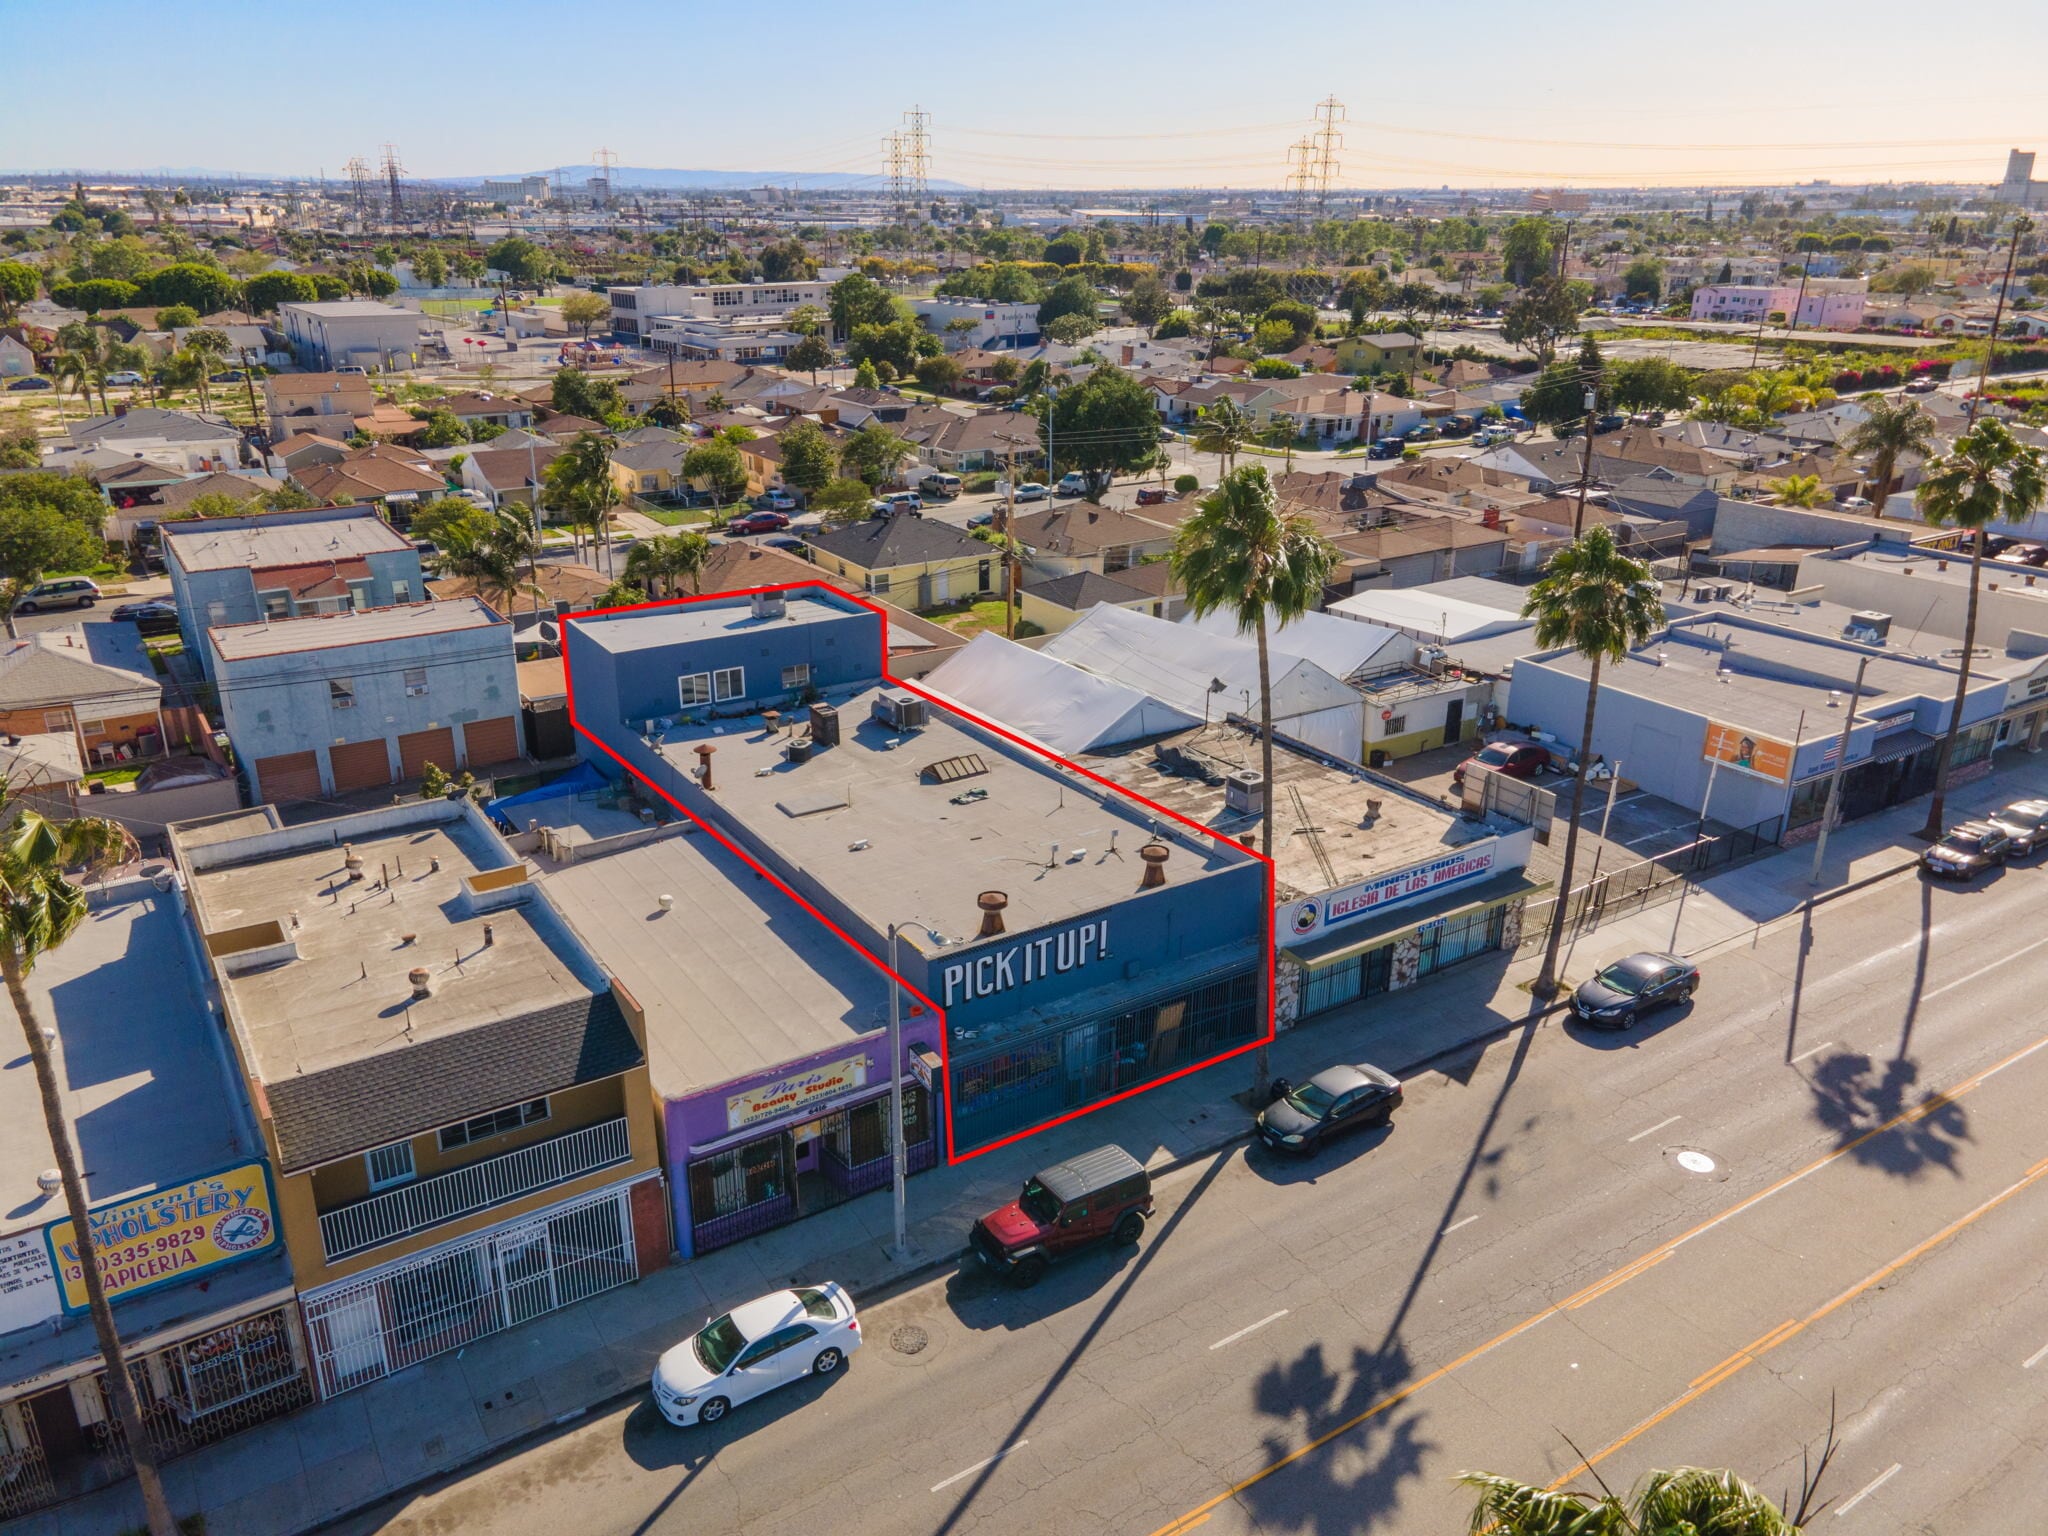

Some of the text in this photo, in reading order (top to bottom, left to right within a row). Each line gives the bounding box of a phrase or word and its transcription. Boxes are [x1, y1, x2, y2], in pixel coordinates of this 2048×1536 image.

[1332, 887, 1379, 917] IGLESIA
[1384, 883, 1399, 900] DE
[1405, 874, 1428, 893] LAS
[1433, 853, 1492, 884] AMERICAS
[1364, 854, 1466, 893] MINISTERIOS
[944, 919, 1108, 1008] PICK IT UP!
[752, 1076, 845, 1113] Beauty Studio
[762, 1073, 823, 1100] Paris
